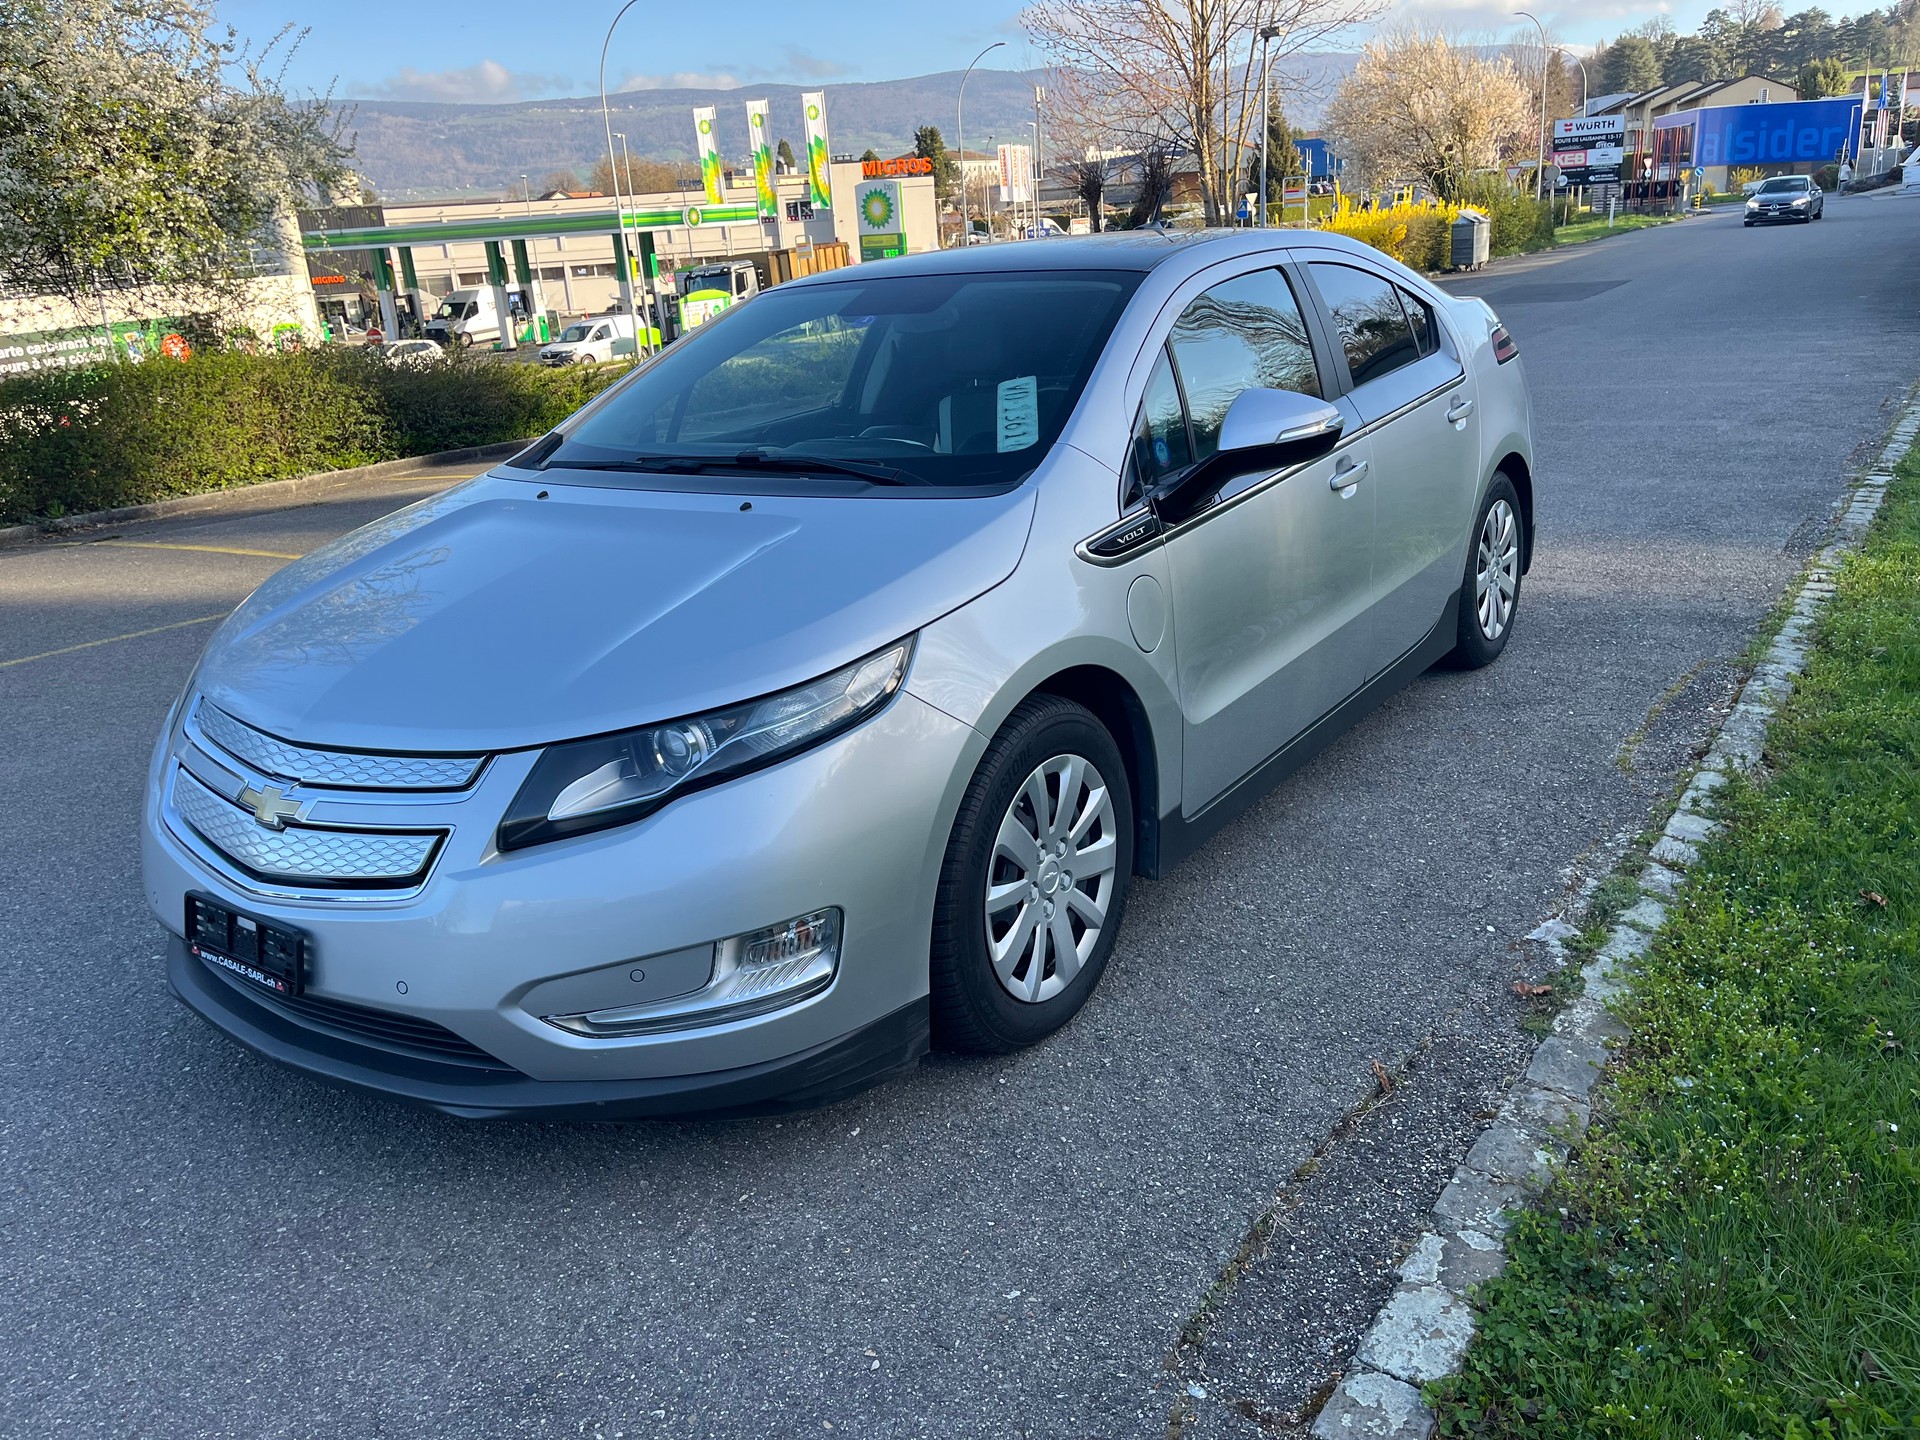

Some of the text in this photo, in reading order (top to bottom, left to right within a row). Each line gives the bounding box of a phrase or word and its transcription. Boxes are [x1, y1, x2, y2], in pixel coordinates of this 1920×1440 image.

[1576, 120, 1615, 131] WÜRTH
[1580, 134, 1607, 142] LAUSANNE
[862, 156, 933, 176] MIGROS
[1554, 152, 1586, 166] KEB
[884, 183, 894, 192] bp
[311, 275, 346, 285] MIGROS
[26, 338, 90, 355] carburant
[43, 355, 66, 367] vos
[1116, 525, 1146, 545] VOLT
[971, 741, 1033, 869] BRIDGESTONE
[200, 949, 276, 989] www.CASALE-SARL.ch
